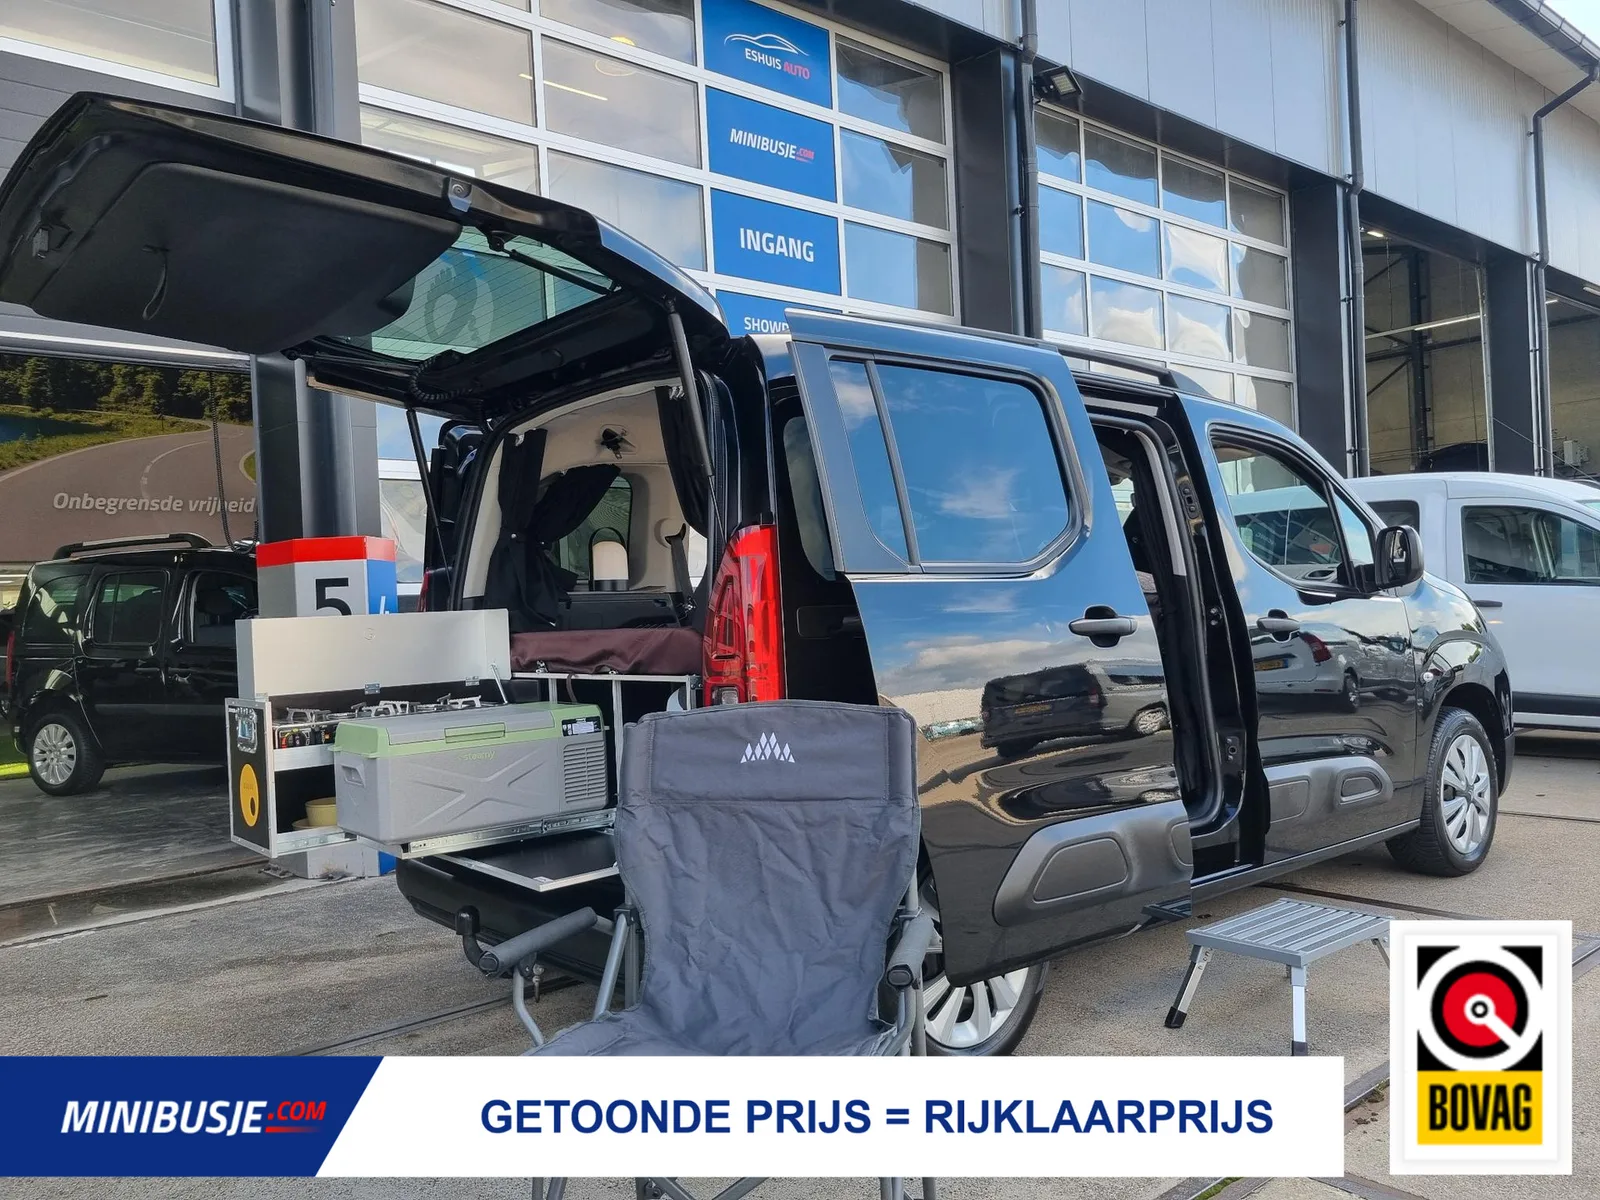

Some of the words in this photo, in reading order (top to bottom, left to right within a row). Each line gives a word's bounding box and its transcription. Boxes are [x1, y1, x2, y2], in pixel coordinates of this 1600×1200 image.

[744, 47, 782, 70] ESHUIS
[783, 61, 811, 80] AUTO
[740, 227, 814, 262] INGANG
[53, 492, 184, 515] Onbegrensde
